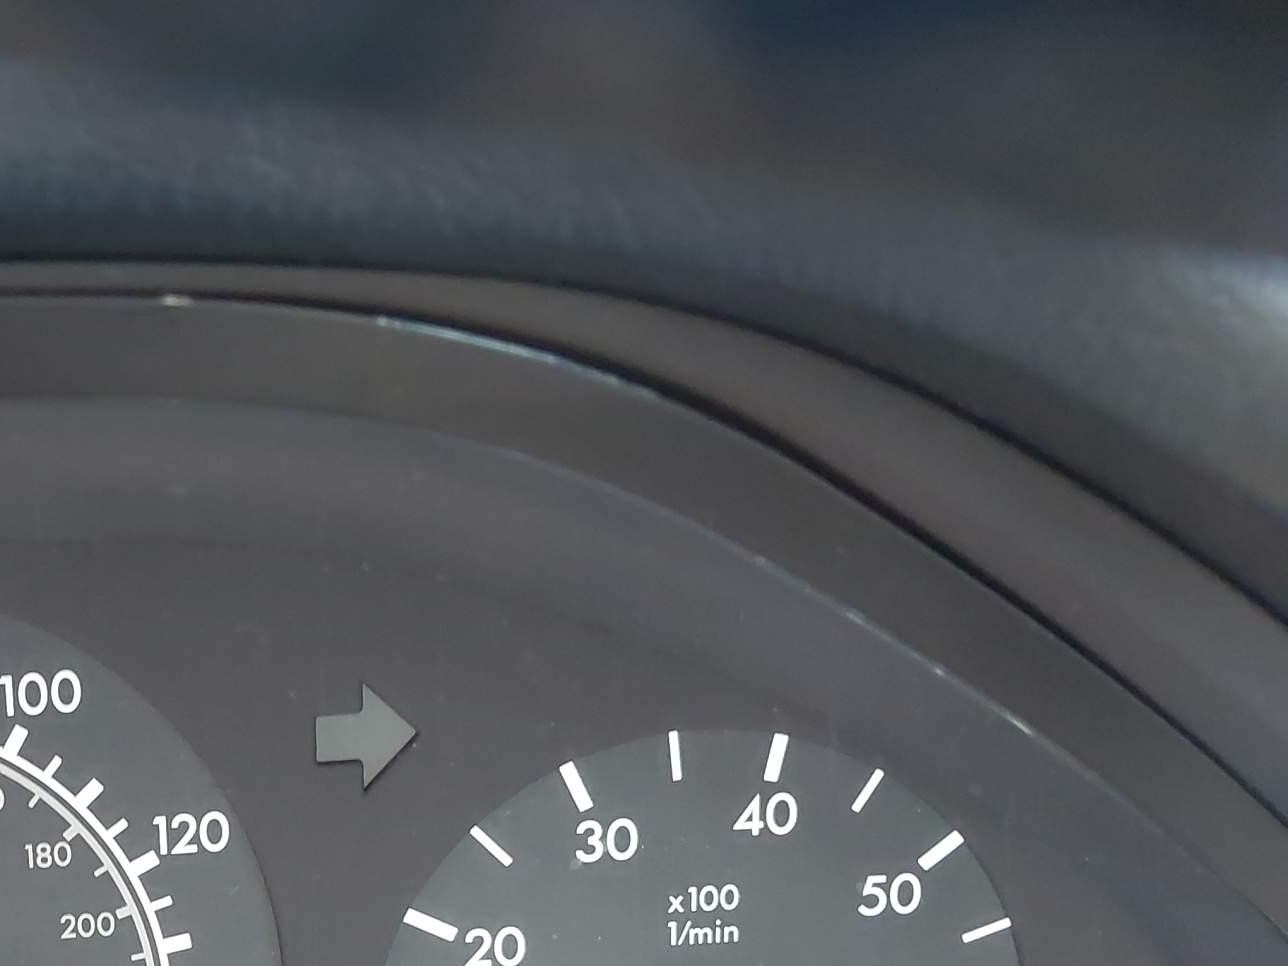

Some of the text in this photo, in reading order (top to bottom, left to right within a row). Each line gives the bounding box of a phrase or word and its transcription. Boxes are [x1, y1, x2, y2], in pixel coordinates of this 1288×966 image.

[0, 669, 82, 717] 100
[152, 811, 230, 856] 120
[733, 793, 798, 837] 40
[24, 841, 72, 869] 180
[575, 818, 639, 862] 30
[668, 884, 741, 913] x100
[857, 873, 922, 917] 50
[60, 912, 115, 939] 200
[667, 920, 740, 946] 1/min
